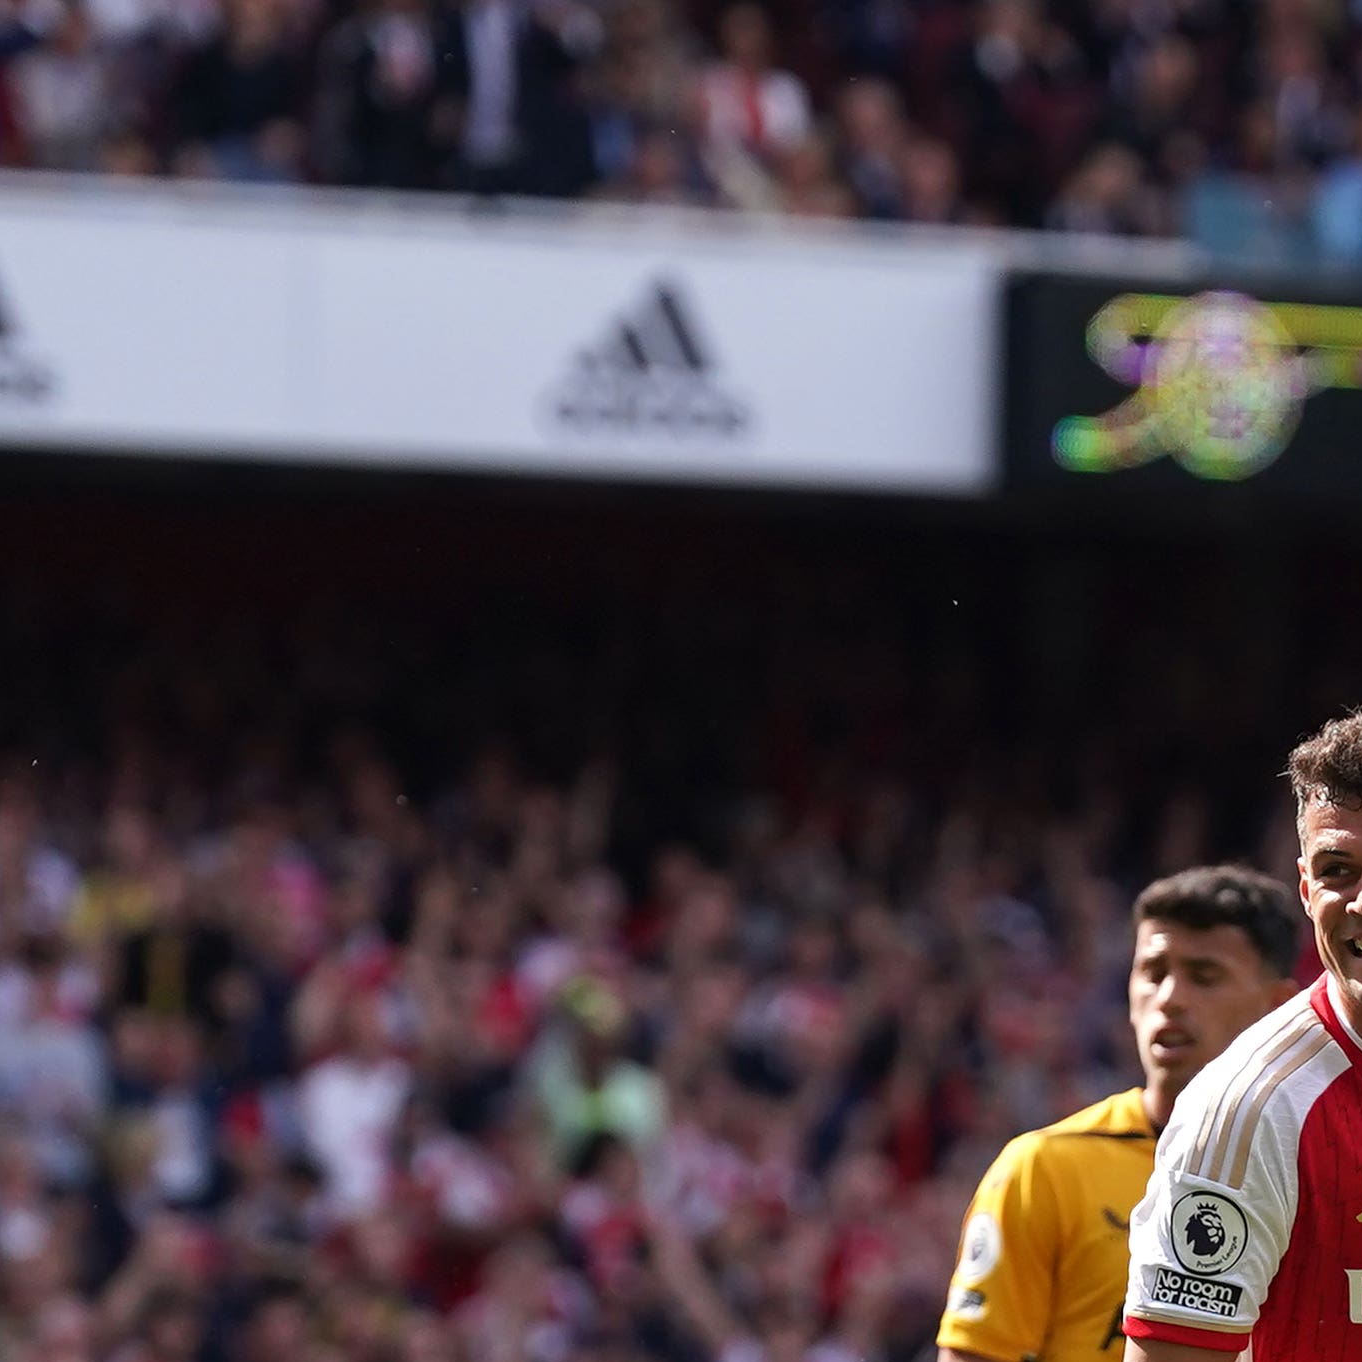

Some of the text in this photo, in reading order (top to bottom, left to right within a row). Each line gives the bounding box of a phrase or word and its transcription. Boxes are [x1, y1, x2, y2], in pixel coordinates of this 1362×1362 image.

[1157, 1269, 1233, 1301] No room
[1179, 1290, 1237, 1317] racism
